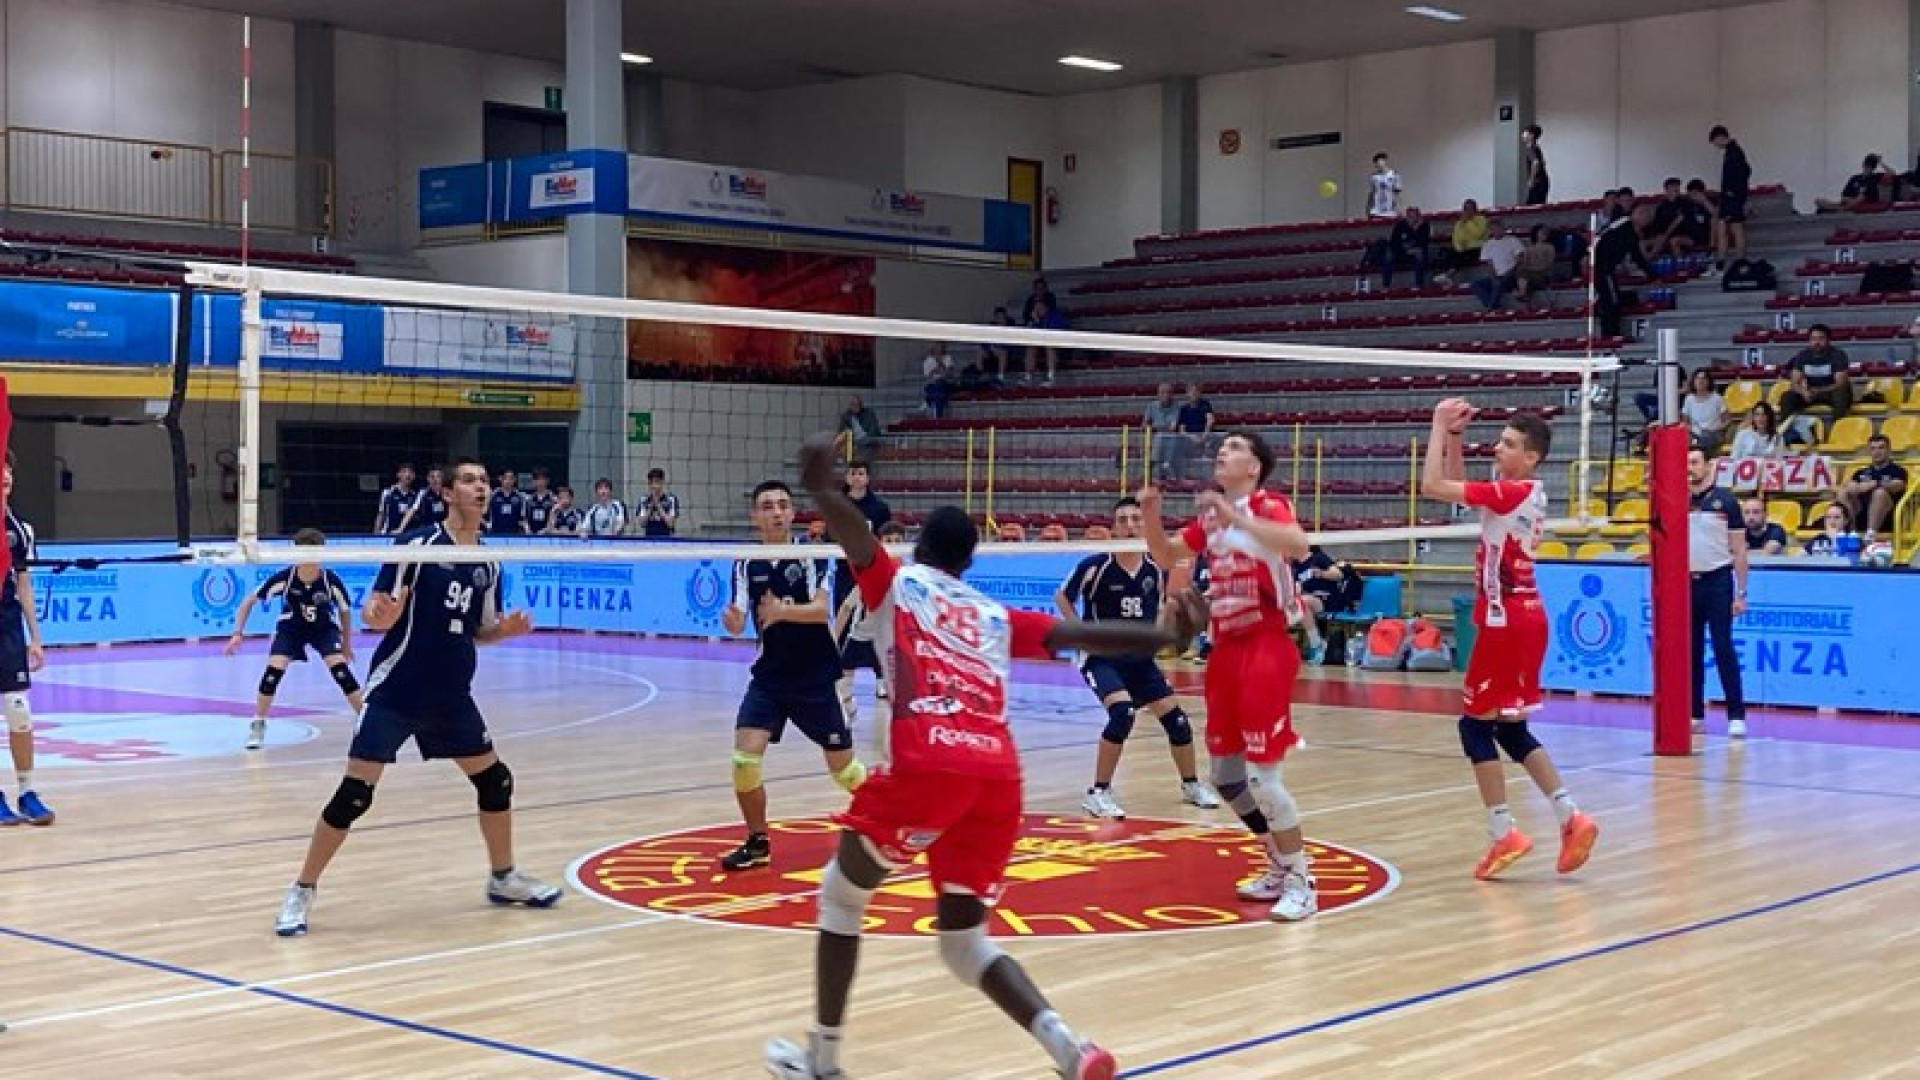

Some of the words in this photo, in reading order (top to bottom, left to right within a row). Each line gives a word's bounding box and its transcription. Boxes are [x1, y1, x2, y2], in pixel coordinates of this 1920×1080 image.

[1715, 455, 1832, 488] FORZA
[443, 579, 473, 613] 94
[525, 585, 632, 612] VICENZA
